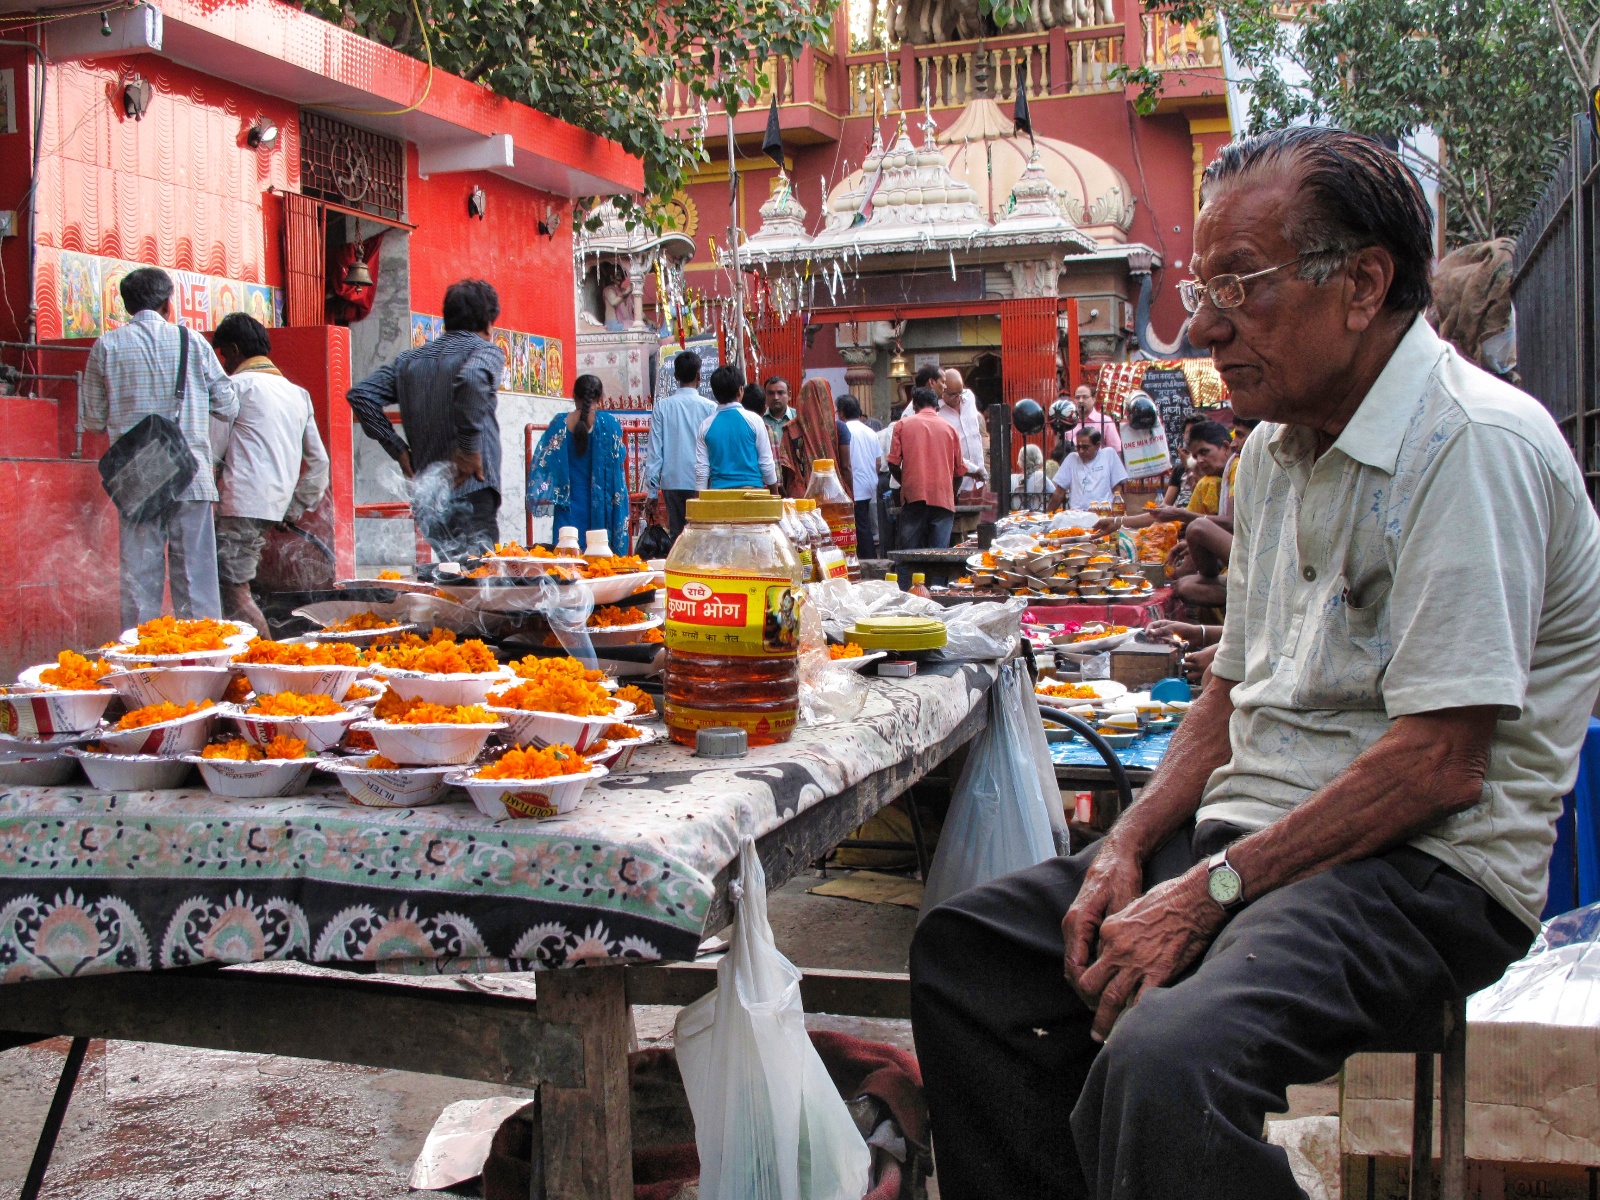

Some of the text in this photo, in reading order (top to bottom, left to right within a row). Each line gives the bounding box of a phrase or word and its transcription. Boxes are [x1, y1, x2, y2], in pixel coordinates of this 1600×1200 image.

[1124, 441, 1136, 449] ONE
[687, 587, 706, 597] राधे
[668, 596, 741, 619] कृष्णा भोग
[705, 633, 717, 642] का
[724, 632, 739, 642] तेल
[366, 780, 396, 802] FILTER
[505, 795, 530, 814] FLAKE
